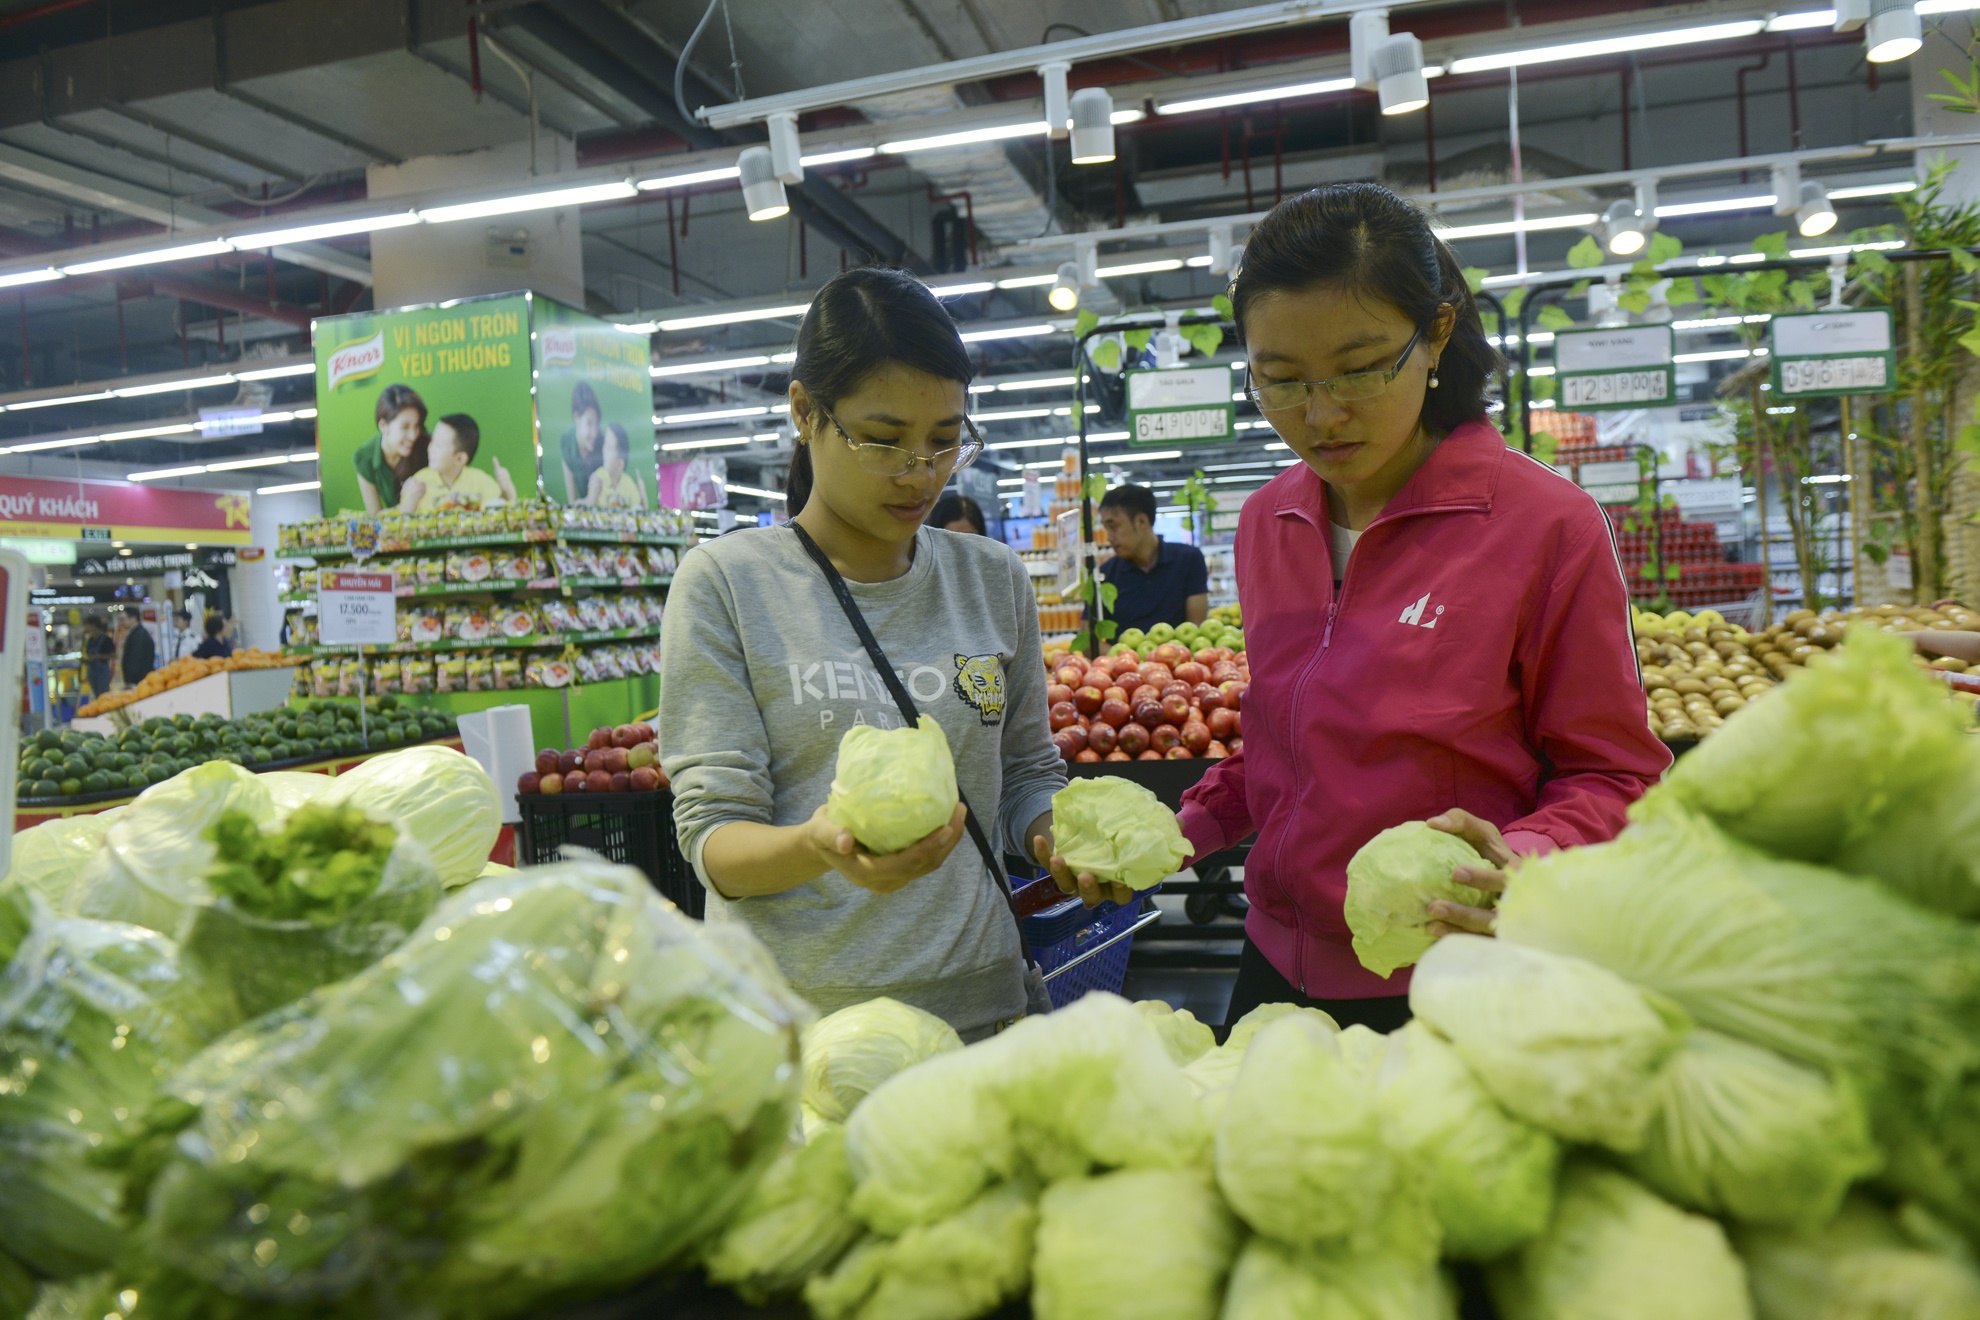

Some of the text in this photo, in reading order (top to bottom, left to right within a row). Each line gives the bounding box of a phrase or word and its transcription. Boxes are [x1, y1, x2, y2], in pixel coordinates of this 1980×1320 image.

[415, 318, 466, 347] NGON
[333, 346, 381, 376] Knorr
[38, 494, 99, 519] KHÁCH
